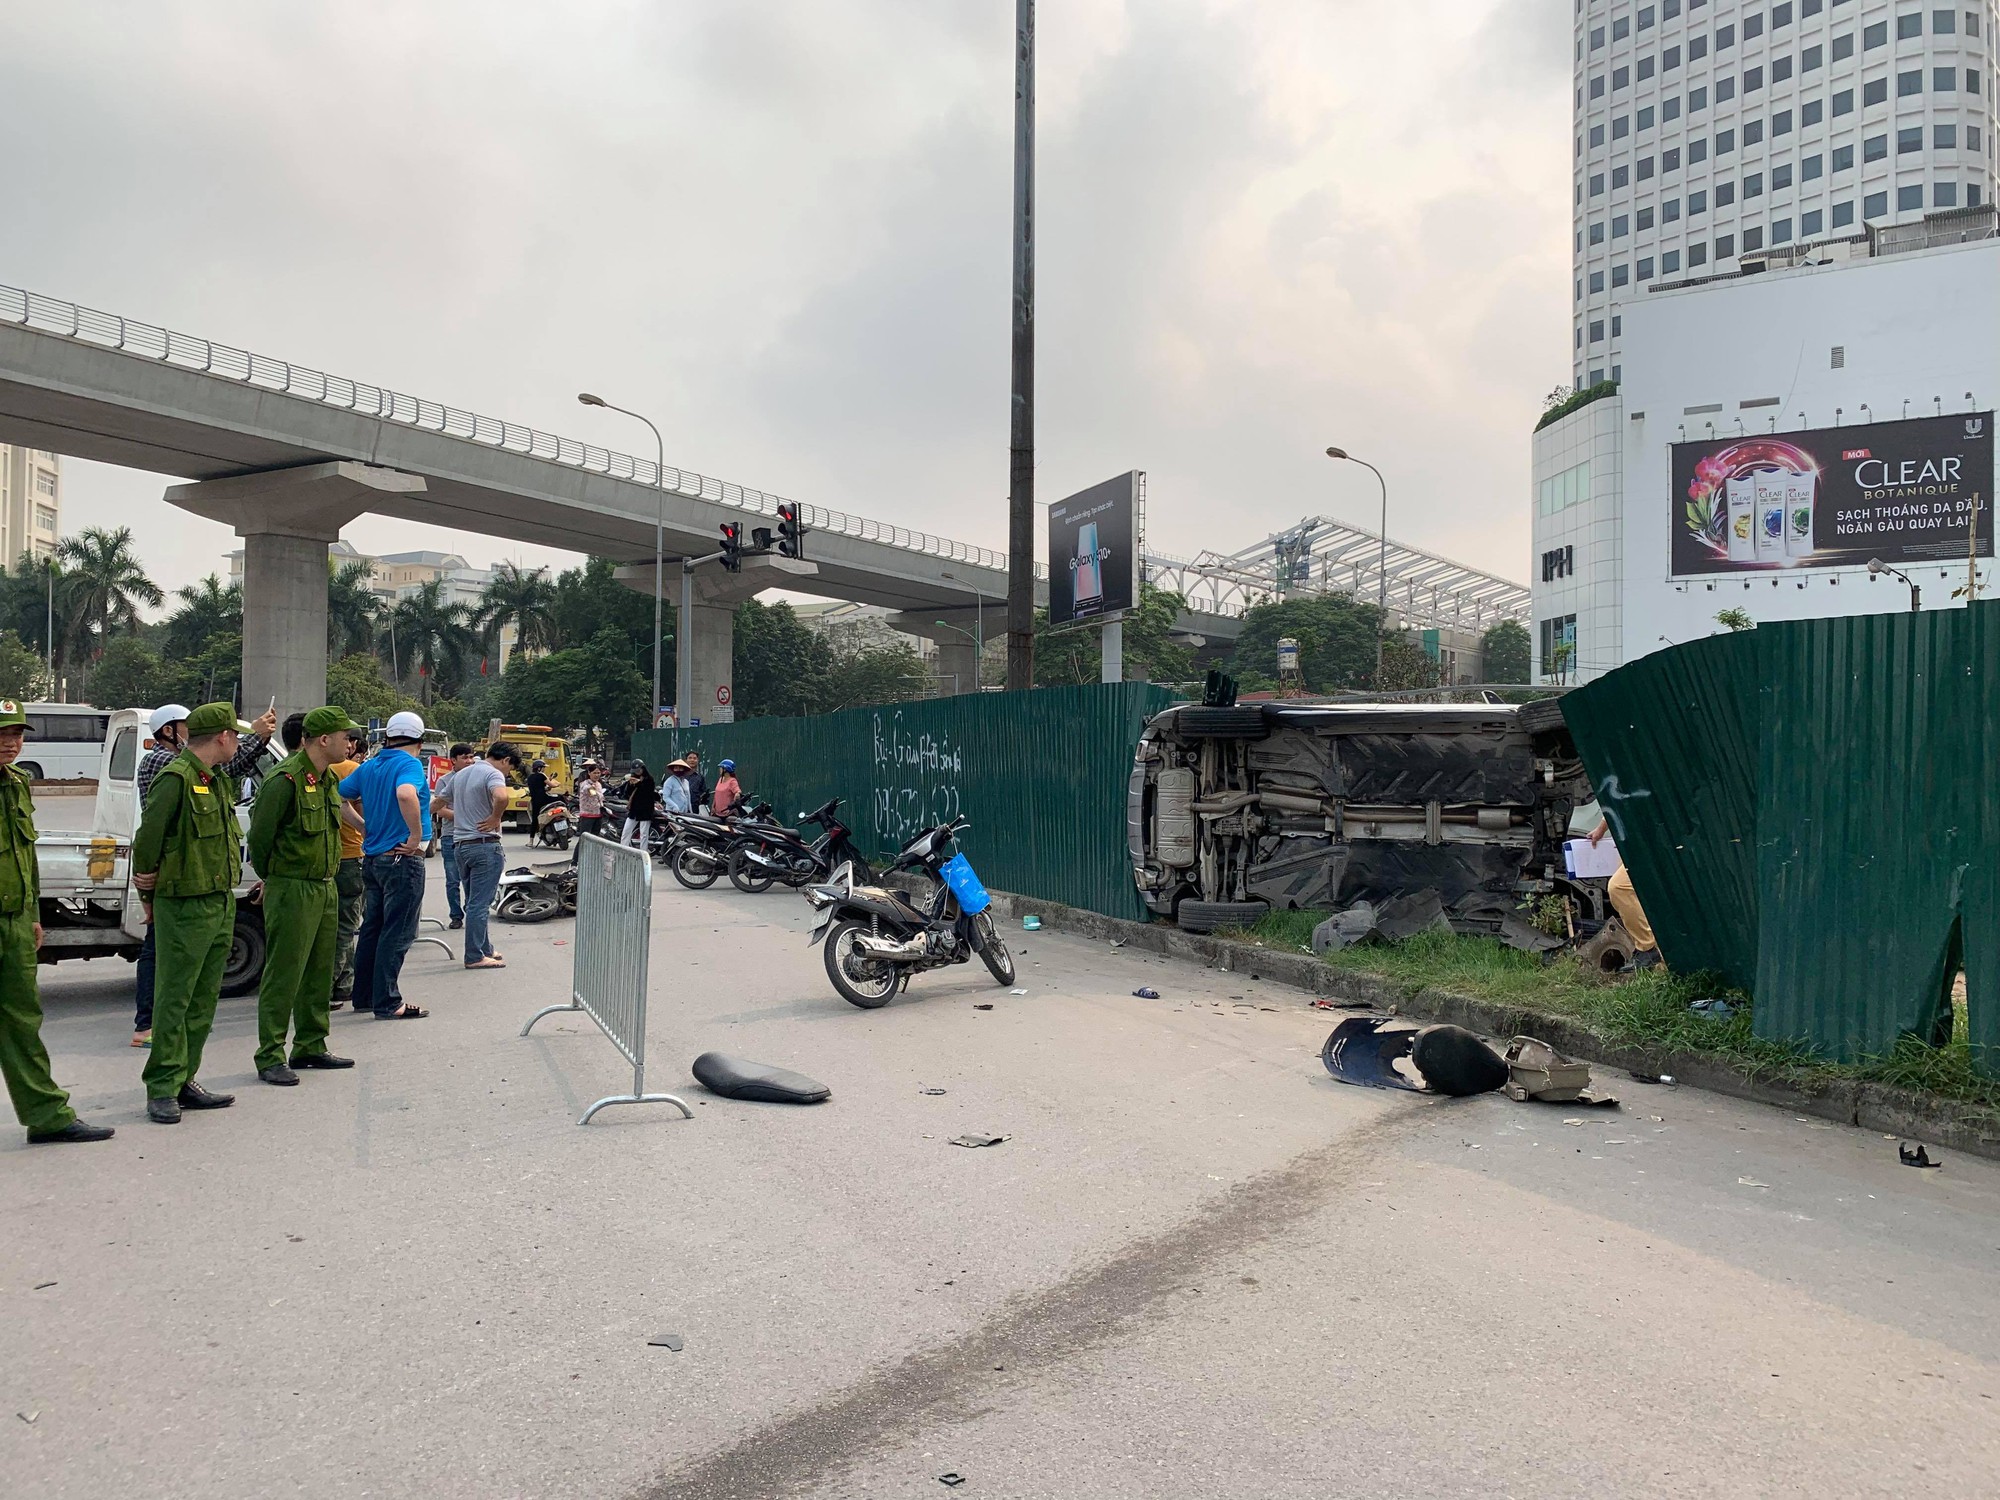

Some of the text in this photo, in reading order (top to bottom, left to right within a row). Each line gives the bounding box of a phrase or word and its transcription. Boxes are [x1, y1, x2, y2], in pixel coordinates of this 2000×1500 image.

[1854, 457, 1962, 489] CLEAR
[1864, 483, 1959, 500] BOTANIQUE
[1836, 508, 1871, 522] SẠCH
[1874, 504, 1929, 518] THOÁNG
[1933, 502, 1951, 513] DA
[1836, 522, 1873, 535] NGĂN
[1909, 517, 1943, 530] QUAY
[1069, 553, 1096, 570] Galaxy
